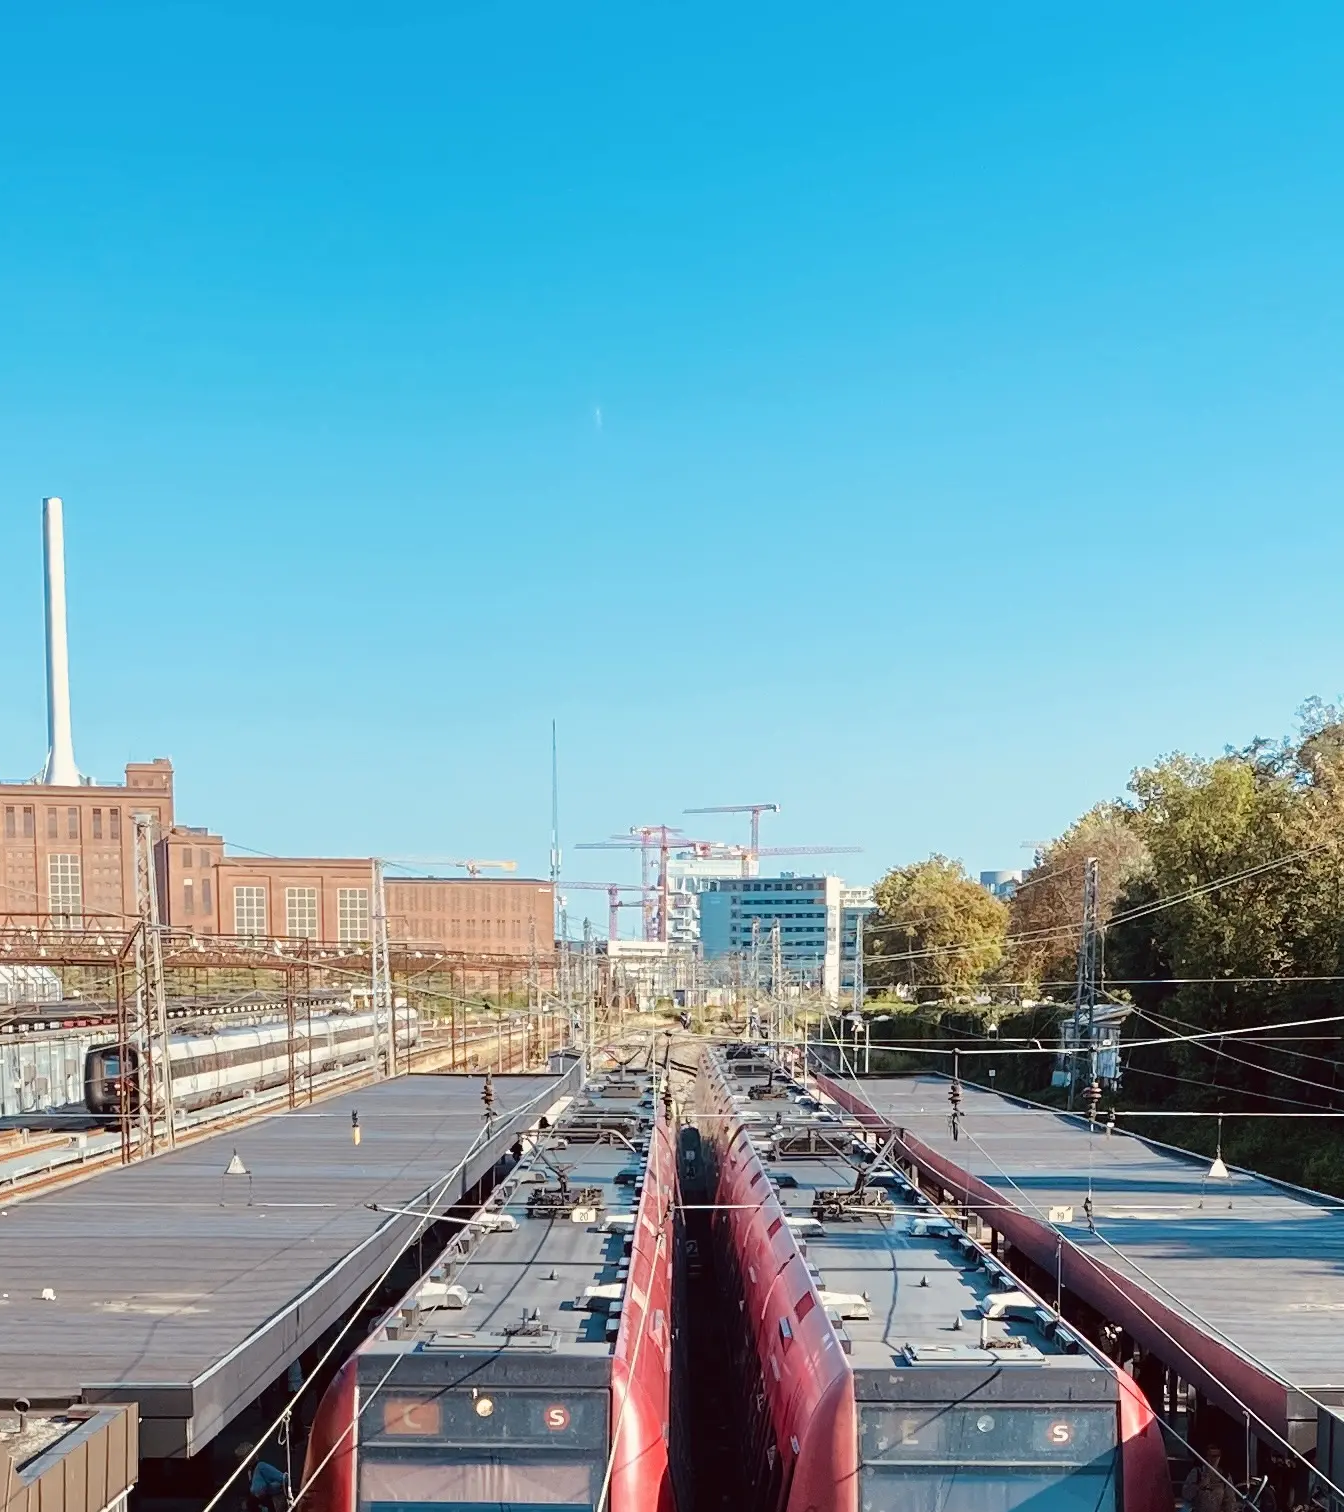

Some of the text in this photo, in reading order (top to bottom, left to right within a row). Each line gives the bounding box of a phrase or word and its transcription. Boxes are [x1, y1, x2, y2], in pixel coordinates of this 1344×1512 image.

[403, 1403, 424, 1429] C
[549, 1409, 565, 1426] S
[902, 1419, 919, 1445] E
[1053, 1425, 1069, 1442] S
